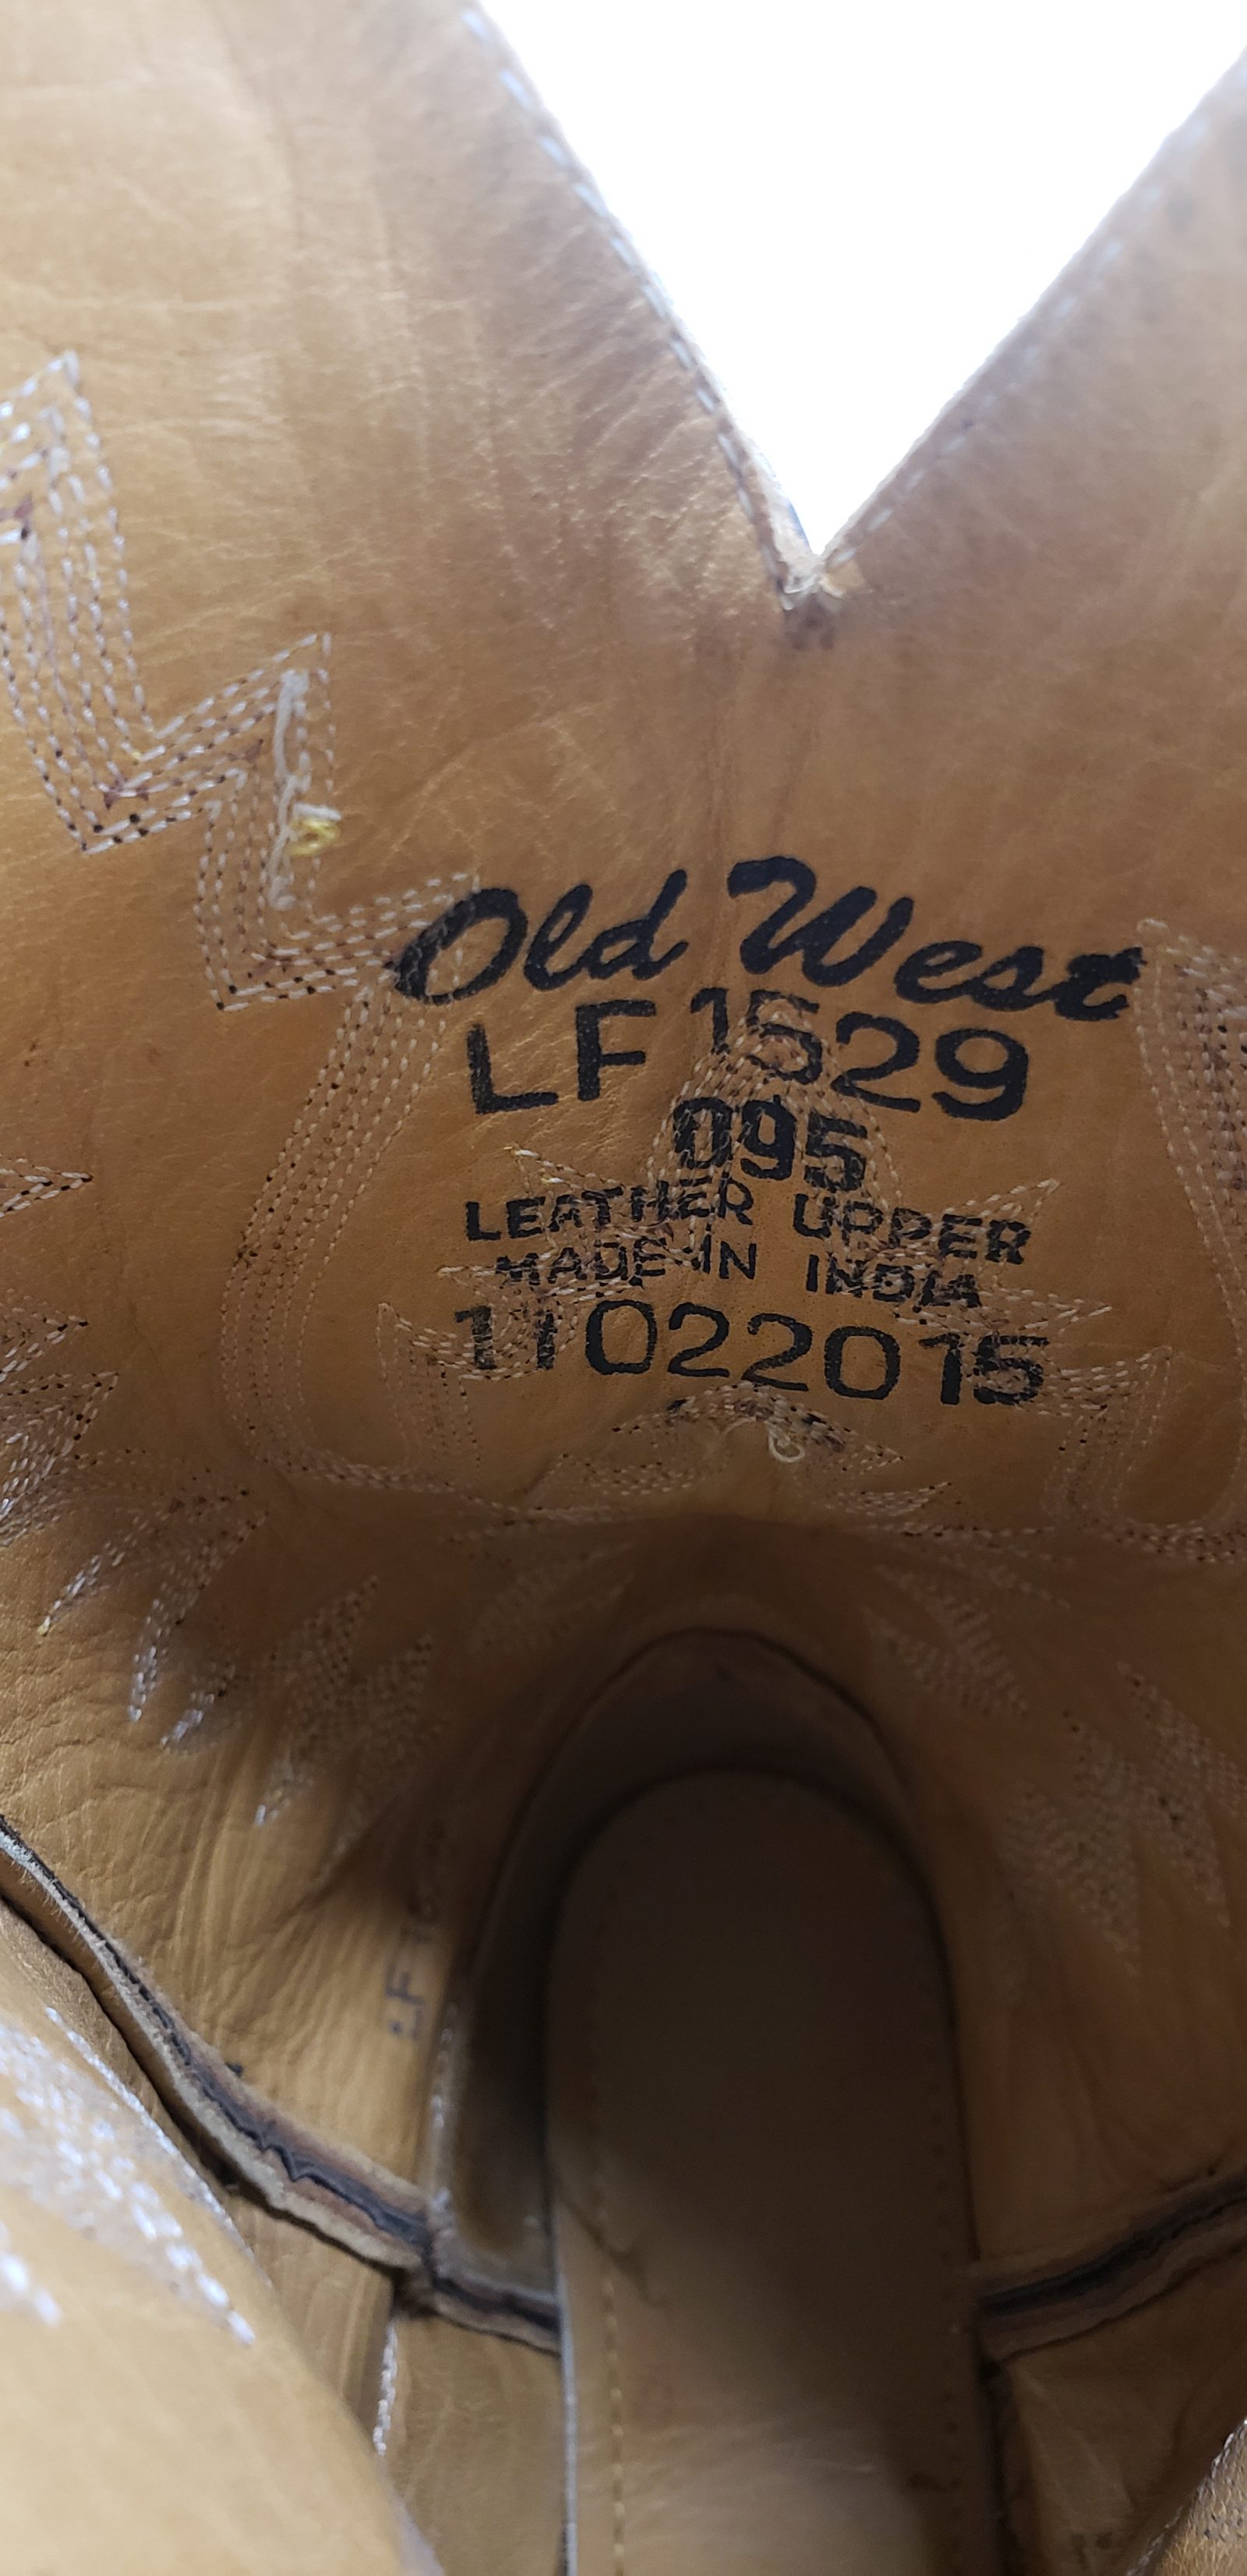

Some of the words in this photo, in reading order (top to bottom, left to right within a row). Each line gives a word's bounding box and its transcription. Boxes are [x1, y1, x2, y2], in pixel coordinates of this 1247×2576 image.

[394, 869, 691, 1005] Old
[726, 856, 1146, 1022] West
[673, 1095, 868, 1193] 095
[465, 1175, 754, 1242] LEATHER
[793, 1193, 1033, 1265] UPPER
[496, 1237, 667, 1287] MADE
[698, 1235, 757, 1280] IN
[805, 1253, 982, 1309] INDIA
[454, 1299, 1050, 1405] 11022015
